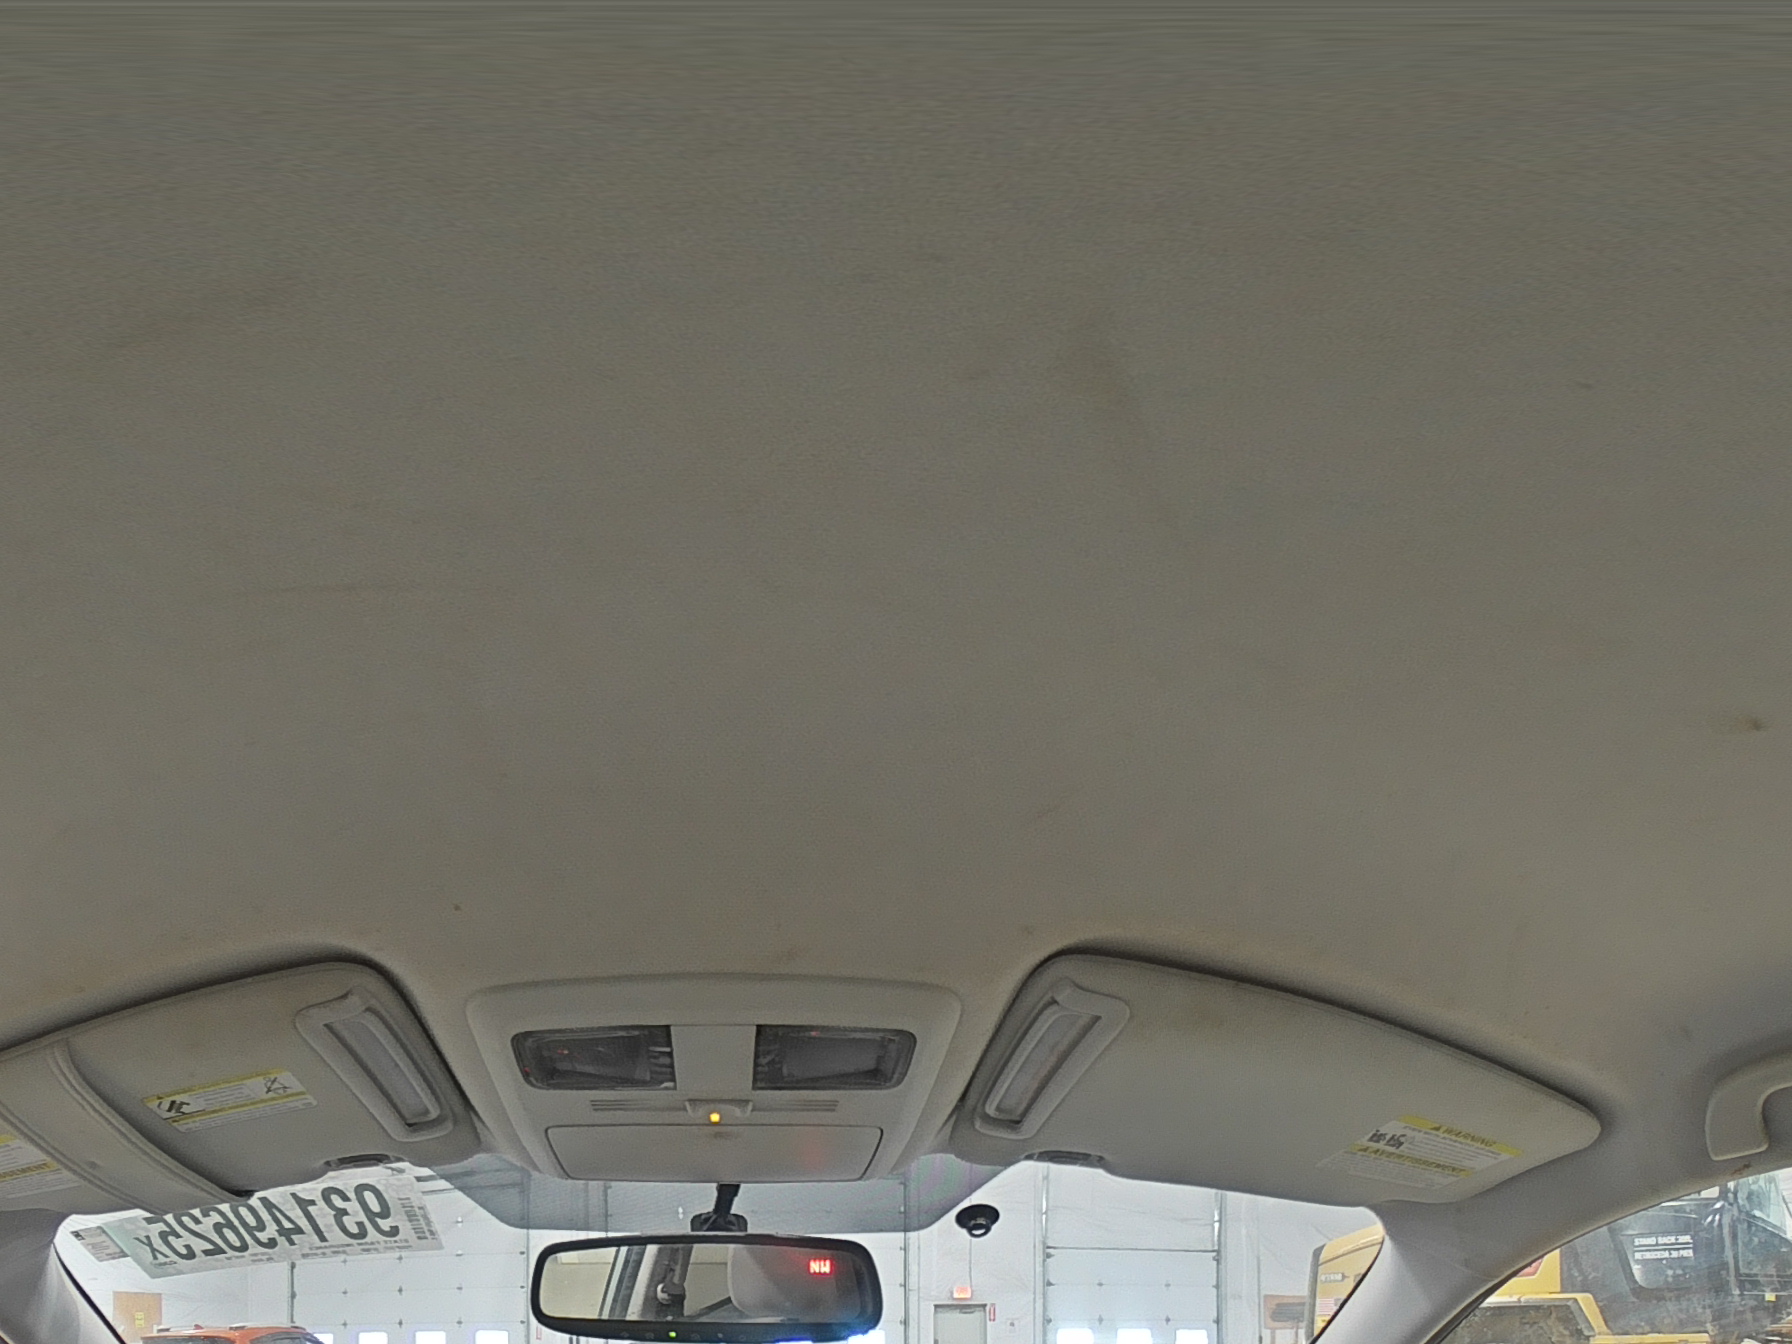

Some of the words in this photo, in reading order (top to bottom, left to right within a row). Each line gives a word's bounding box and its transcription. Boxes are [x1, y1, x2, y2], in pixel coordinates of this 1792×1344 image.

[1442, 1126, 1497, 1148] WARNING
[1372, 1148, 1466, 1174] AVERTISSEMENT
[809, 1259, 831, 1275] NW
